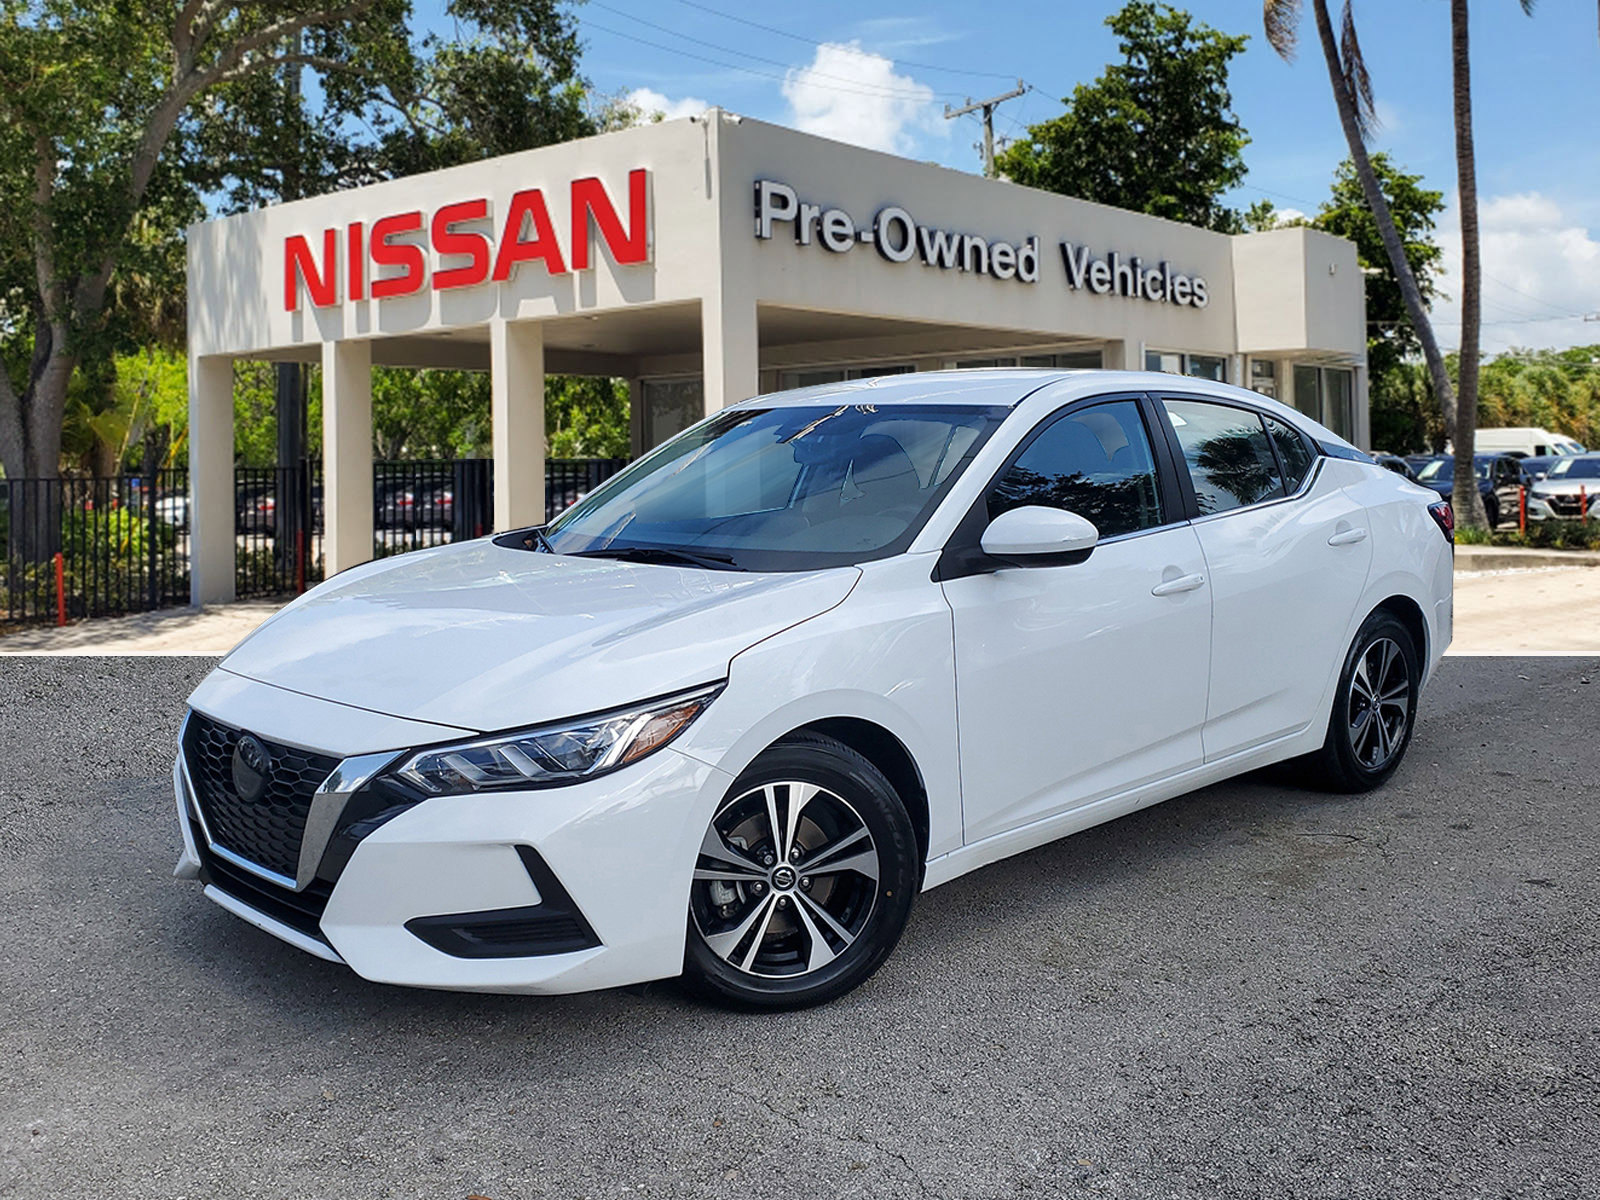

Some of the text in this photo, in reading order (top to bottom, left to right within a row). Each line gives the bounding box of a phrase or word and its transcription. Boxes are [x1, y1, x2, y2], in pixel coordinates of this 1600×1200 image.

[285, 169, 648, 312] NISSAN
[755, 180, 1209, 308] Pre-Owned Vehicles
